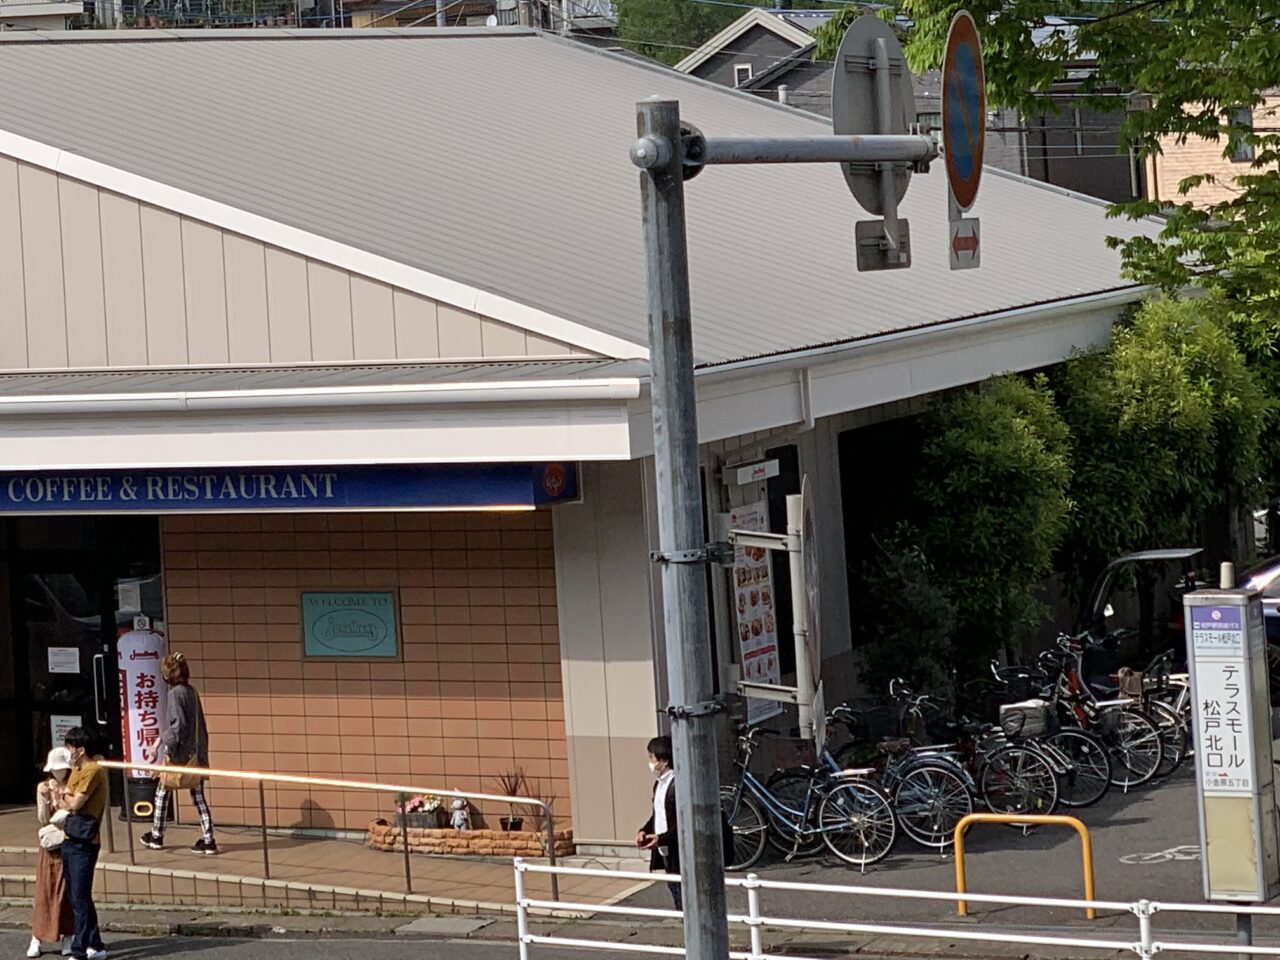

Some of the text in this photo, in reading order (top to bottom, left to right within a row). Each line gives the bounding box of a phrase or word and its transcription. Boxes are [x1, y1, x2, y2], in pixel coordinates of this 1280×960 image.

[7, 472, 337, 503] COFFEE & RESTAURANT
[1202, 699, 1224, 768] 松戸北口
[1222, 665, 1245, 769] テラスモール
